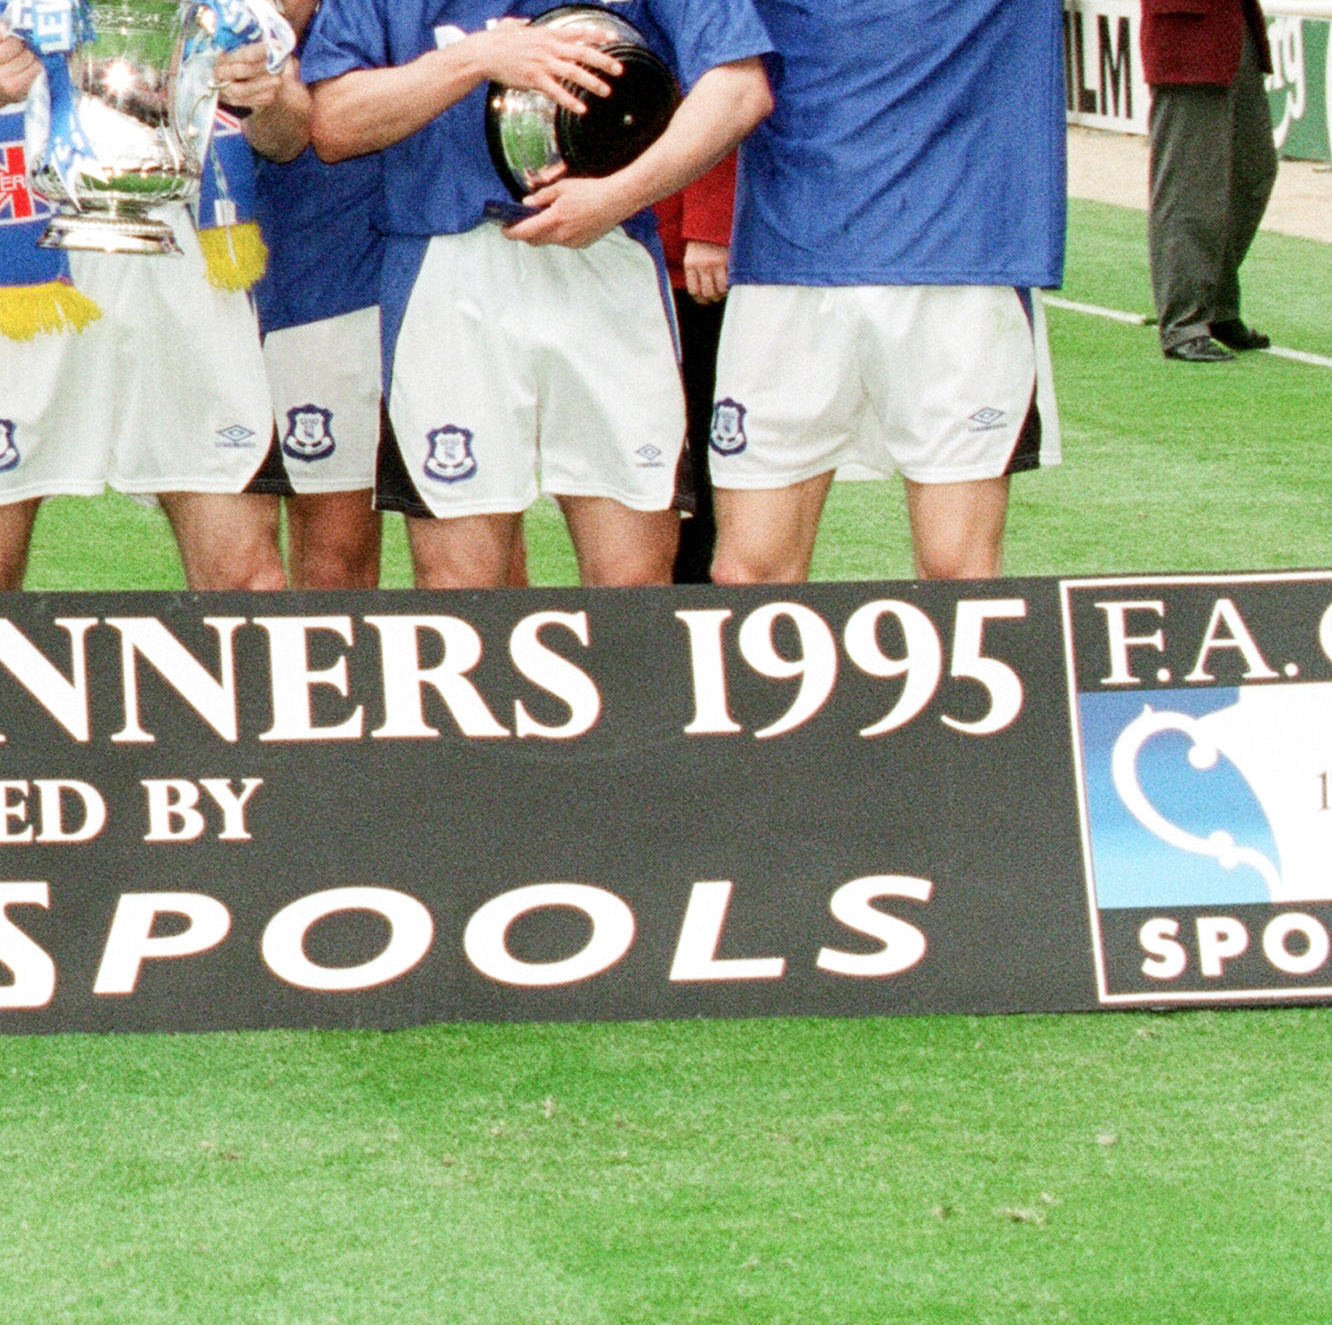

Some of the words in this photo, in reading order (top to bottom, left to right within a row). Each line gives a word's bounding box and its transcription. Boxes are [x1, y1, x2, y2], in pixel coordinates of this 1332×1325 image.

[675, 598, 1028, 740] 1995
[1094, 597, 1301, 686] F.A.
[142, 778, 264, 841] BY
[92, 874, 934, 995] POOLS
